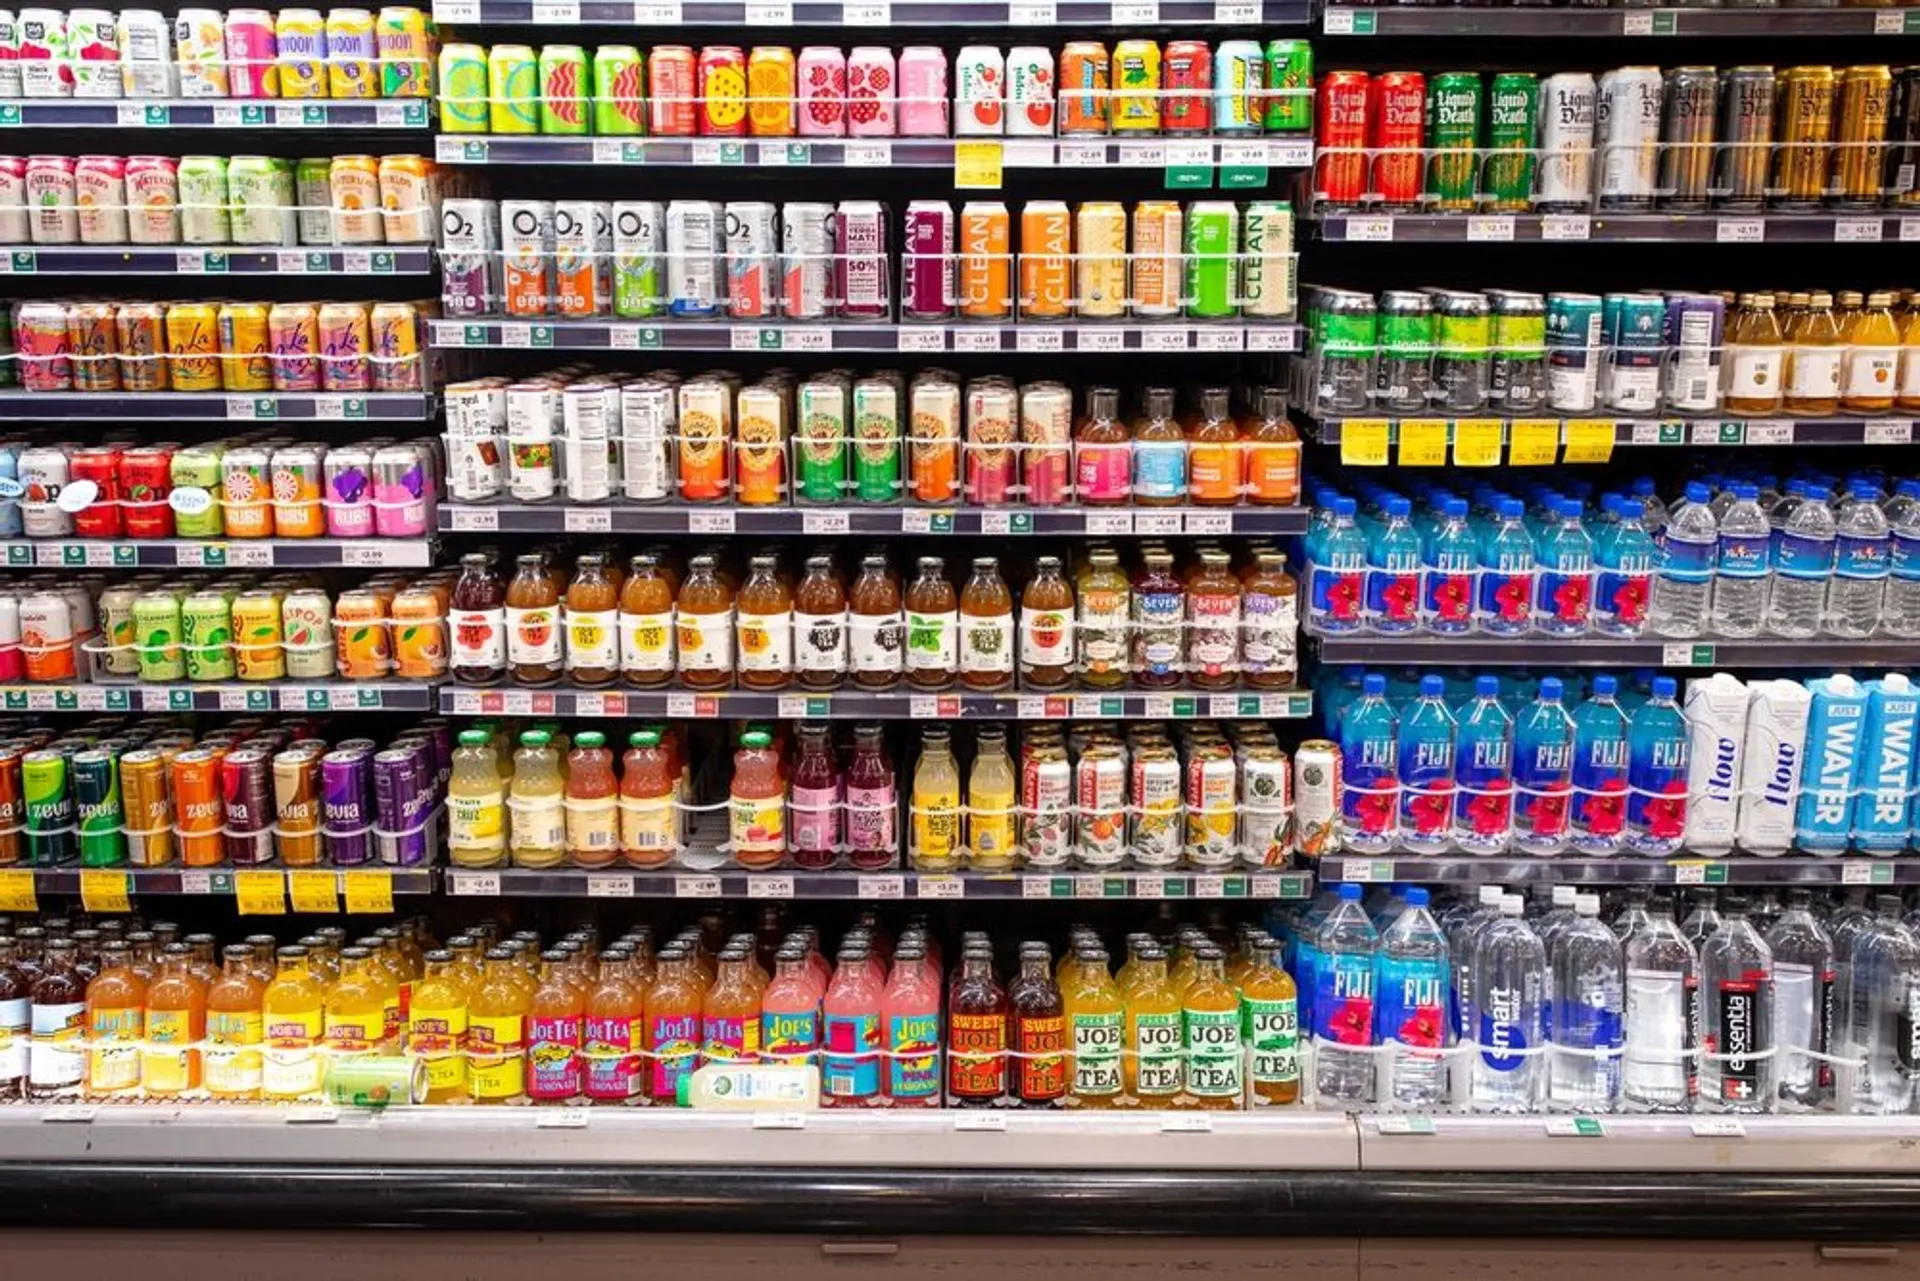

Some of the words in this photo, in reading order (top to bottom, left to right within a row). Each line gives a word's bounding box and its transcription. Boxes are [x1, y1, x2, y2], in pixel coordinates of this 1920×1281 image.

[1328, 90, 1366, 107] Liquid
[1385, 90, 1422, 107] Liquid
[1437, 90, 1476, 107] Liquid
[1491, 90, 1528, 107] Liquid
[1330, 107, 1366, 124] Death
[1386, 108, 1422, 124] Death
[1438, 107, 1475, 124] Death
[1492, 108, 1527, 124] Death
[848, 260, 877, 272] 50%
[970, 215, 991, 303] CLEAN
[1045, 215, 1065, 303] CLEAN
[1246, 214, 1263, 300] CLEAN
[335, 506, 370, 525] RUBY
[1143, 597, 1179, 609] SEVEN
[1198, 598, 1233, 609] SEVEN
[1363, 740, 1396, 764] FIJI
[1417, 743, 1450, 766] FIJI
[1474, 741, 1507, 766] FIJI
[1536, 745, 1569, 769] FIJI
[1590, 740, 1625, 766] FIJI
[1653, 741, 1687, 767] FIJI
[1814, 721, 1858, 825] WATER
[1873, 719, 1914, 824] WATER
[326, 802, 360, 819] evia
[1334, 971, 1371, 999] FIJI
[1403, 979, 1442, 1006] FIJI
[769, 1015, 812, 1039] JOE'S
[952, 1016, 1000, 1029] SWEET
[1255, 1014, 1296, 1031] JOE
[1490, 986, 1511, 1061] smart
[955, 1031, 995, 1047] JOE
[1077, 1028, 1118, 1045] JOE
[1141, 1026, 1182, 1044] JOE
[1192, 1026, 1236, 1044] JOE
[1730, 995, 1745, 1072] essentia
[1256, 1055, 1297, 1073] TEA
[956, 1072, 997, 1089] TEA
[1078, 1069, 1120, 1087] TEA
[1143, 1069, 1181, 1087] TEA
[1193, 1068, 1237, 1087] TEA
